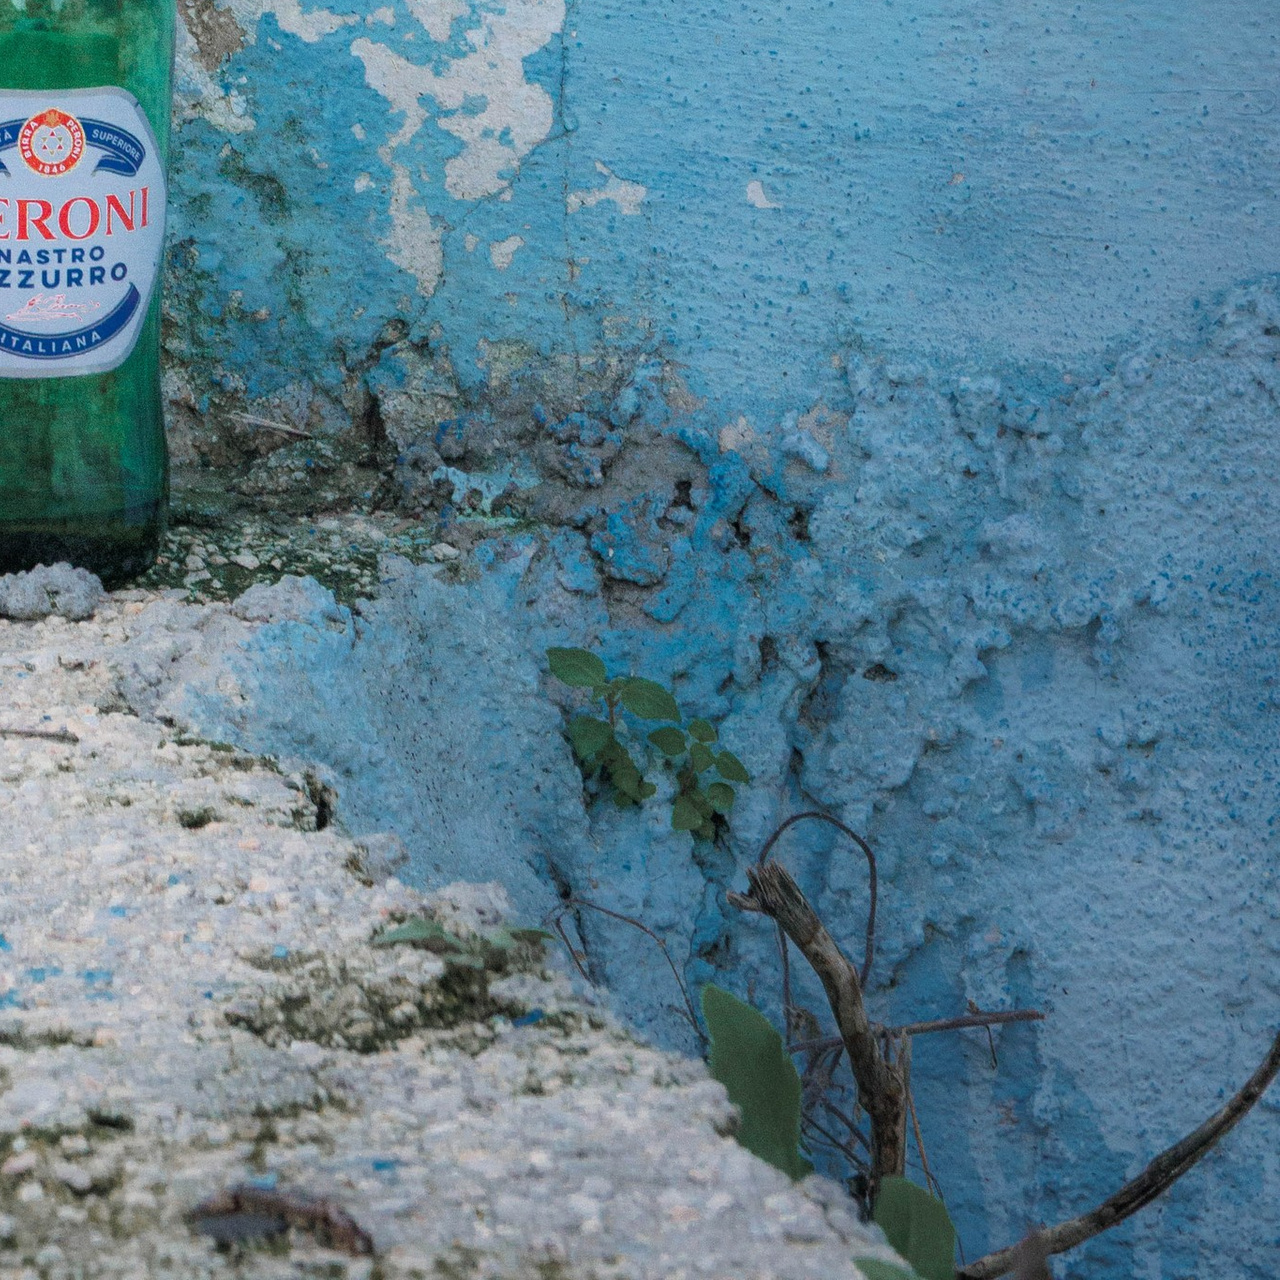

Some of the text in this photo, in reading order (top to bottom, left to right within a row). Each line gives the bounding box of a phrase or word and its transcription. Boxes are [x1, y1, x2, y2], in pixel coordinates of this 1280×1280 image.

[22, 119, 82, 159] BIRRA PERONI
[91, 128, 141, 161] SUPERIORE
[38, 163, 66, 174] 1846
[0, 331, 102, 353] ITALIANA
